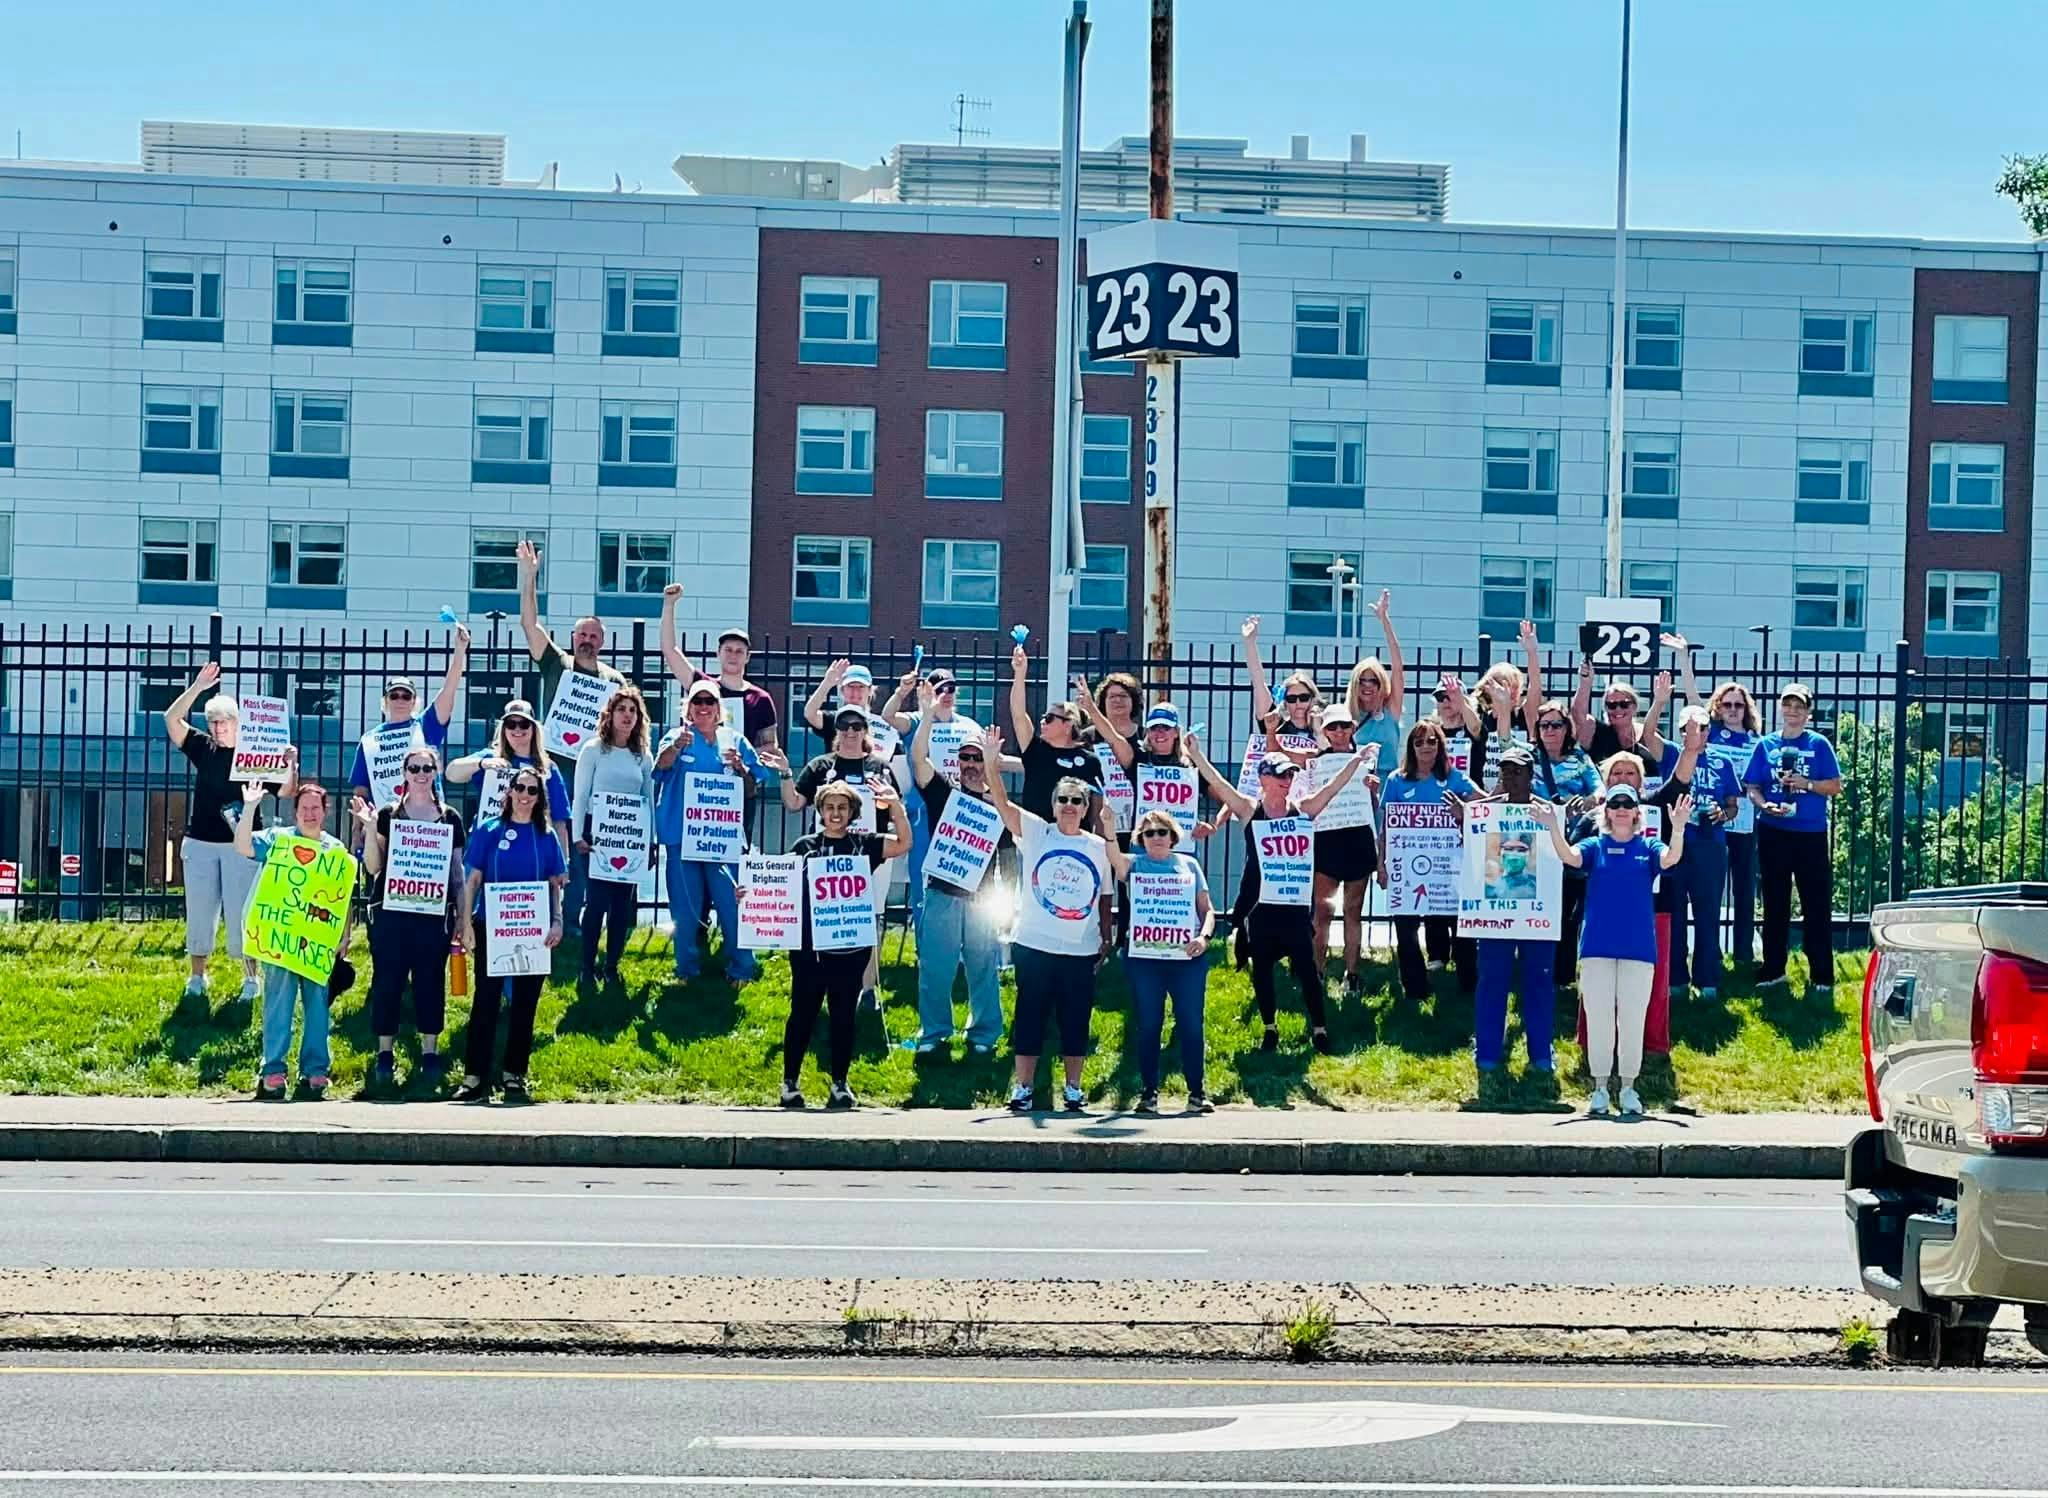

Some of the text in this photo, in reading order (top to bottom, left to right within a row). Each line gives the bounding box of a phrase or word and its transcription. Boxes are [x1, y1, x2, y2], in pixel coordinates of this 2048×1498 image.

[1097, 272, 1150, 349] 23
[1168, 272, 1232, 346] 23
[1146, 375, 1158, 497] 2309
[1592, 625, 1651, 665] 23
[571, 675, 607, 692] Brigham
[571, 688, 599, 704] Nurses
[551, 710, 597, 731] Patient Car
[375, 731, 411, 742] Brigham
[379, 741, 409, 752] Nurses
[235, 753, 289, 769] PROFITS
[373, 768, 402, 780] Patien
[1153, 768, 1181, 780] MGB
[694, 777, 734, 790] Brigham
[698, 793, 730, 805] Nurses
[1143, 781, 1194, 805] STOP
[606, 795, 641, 808] Brigham
[609, 810, 637, 821] Nurses
[686, 807, 741, 823] ON STRIKE
[957, 797, 998, 821] Brigham
[1388, 804, 1416, 816] BWH
[1471, 804, 1490, 818] I'D
[955, 811, 988, 833] Nurses
[1270, 820, 1296, 833] MGB
[1388, 815, 1457, 827] ON STRIK
[395, 823, 449, 837] Mass General
[600, 822, 643, 838] Protecting
[687, 825, 738, 838] for Patient
[1472, 824, 1486, 834] BE
[401, 836, 440, 849] Brigham:
[595, 837, 646, 851] Patient Care
[938, 822, 994, 854] ON STRIKE
[696, 840, 727, 855] Safety
[1261, 835, 1309, 857] STOP
[392, 849, 447, 860] Put Patients
[934, 839, 985, 868] for Patient
[413, 860, 443, 871] Nurses
[745, 860, 795, 870] Mass General
[826, 857, 853, 873] MGB
[937, 857, 973, 879] Safety
[268, 862, 307, 886] TO
[403, 870, 432, 879] Above
[752, 874, 788, 884] Brigham:
[1135, 876, 1190, 885] Mass General
[388, 879, 445, 899] PROFITS
[814, 875, 867, 900] STOP
[1391, 857, 1402, 909] We Get
[500, 892, 535, 902] FIGHTING
[753, 888, 787, 897] Value the
[1143, 886, 1183, 897] Brigham:
[745, 901, 795, 910] Essential Care
[1153, 898, 1191, 907] Patients
[1462, 900, 1543, 911] BUT THIS IS
[256, 903, 294, 926] THE
[500, 910, 535, 920] PATIENTS
[813, 904, 872, 915] Closing Essential
[1157, 908, 1188, 916] Nurses
[741, 914, 798, 924] Brigham Nurses
[815, 916, 872, 927] Patient Services
[1148, 917, 1178, 925] Above
[1526, 919, 1551, 929] TOO
[495, 928, 542, 937] PROFESSION
[756, 928, 784, 937] Provide
[831, 931, 839, 939] at
[1133, 926, 1191, 944] PROFITS
[270, 928, 336, 975] NURSES
